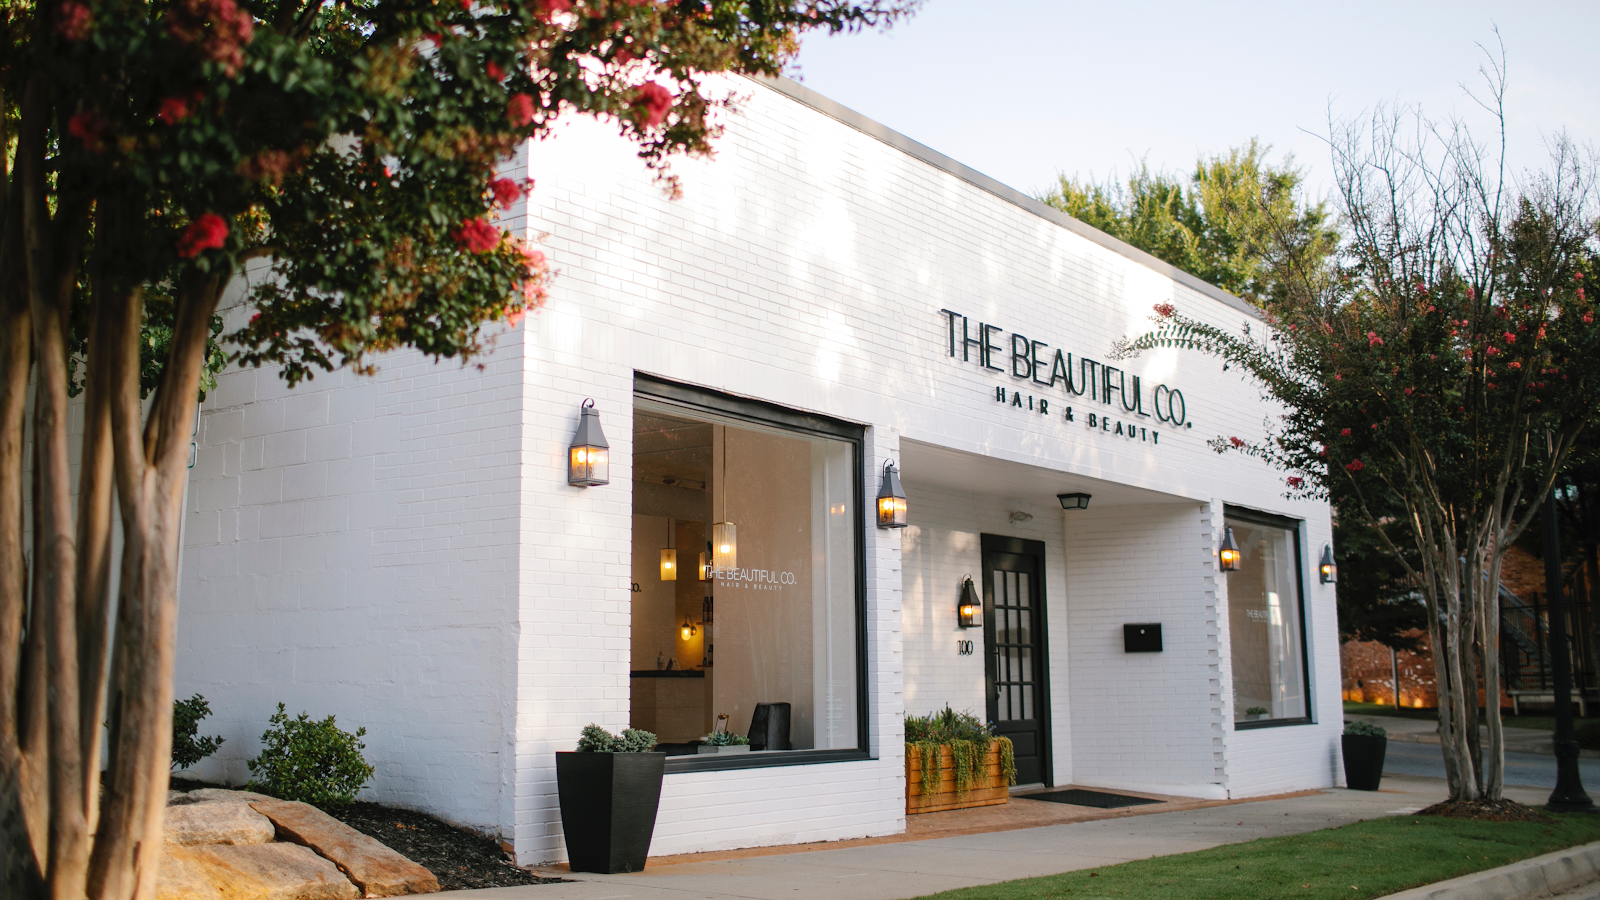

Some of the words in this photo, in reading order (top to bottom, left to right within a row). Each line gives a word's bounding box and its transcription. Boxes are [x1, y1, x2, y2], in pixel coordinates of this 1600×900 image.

[940, 308, 1004, 373] THE
[1011, 332, 1151, 418] BEAUTIFUL
[1154, 384, 1192, 429] CO.
[995, 386, 1049, 415] HAIR
[1064, 406, 1074, 422] &
[1088, 413, 1159, 444] BEAUTY
[705, 564, 725, 580] THE
[726, 567, 779, 584] BEAUTIFUL
[780, 571, 797, 585] CO.
[630, 582, 642, 592] O.
[753, 583, 783, 591] BEAUTY
[957, 640, 973, 655] 100
